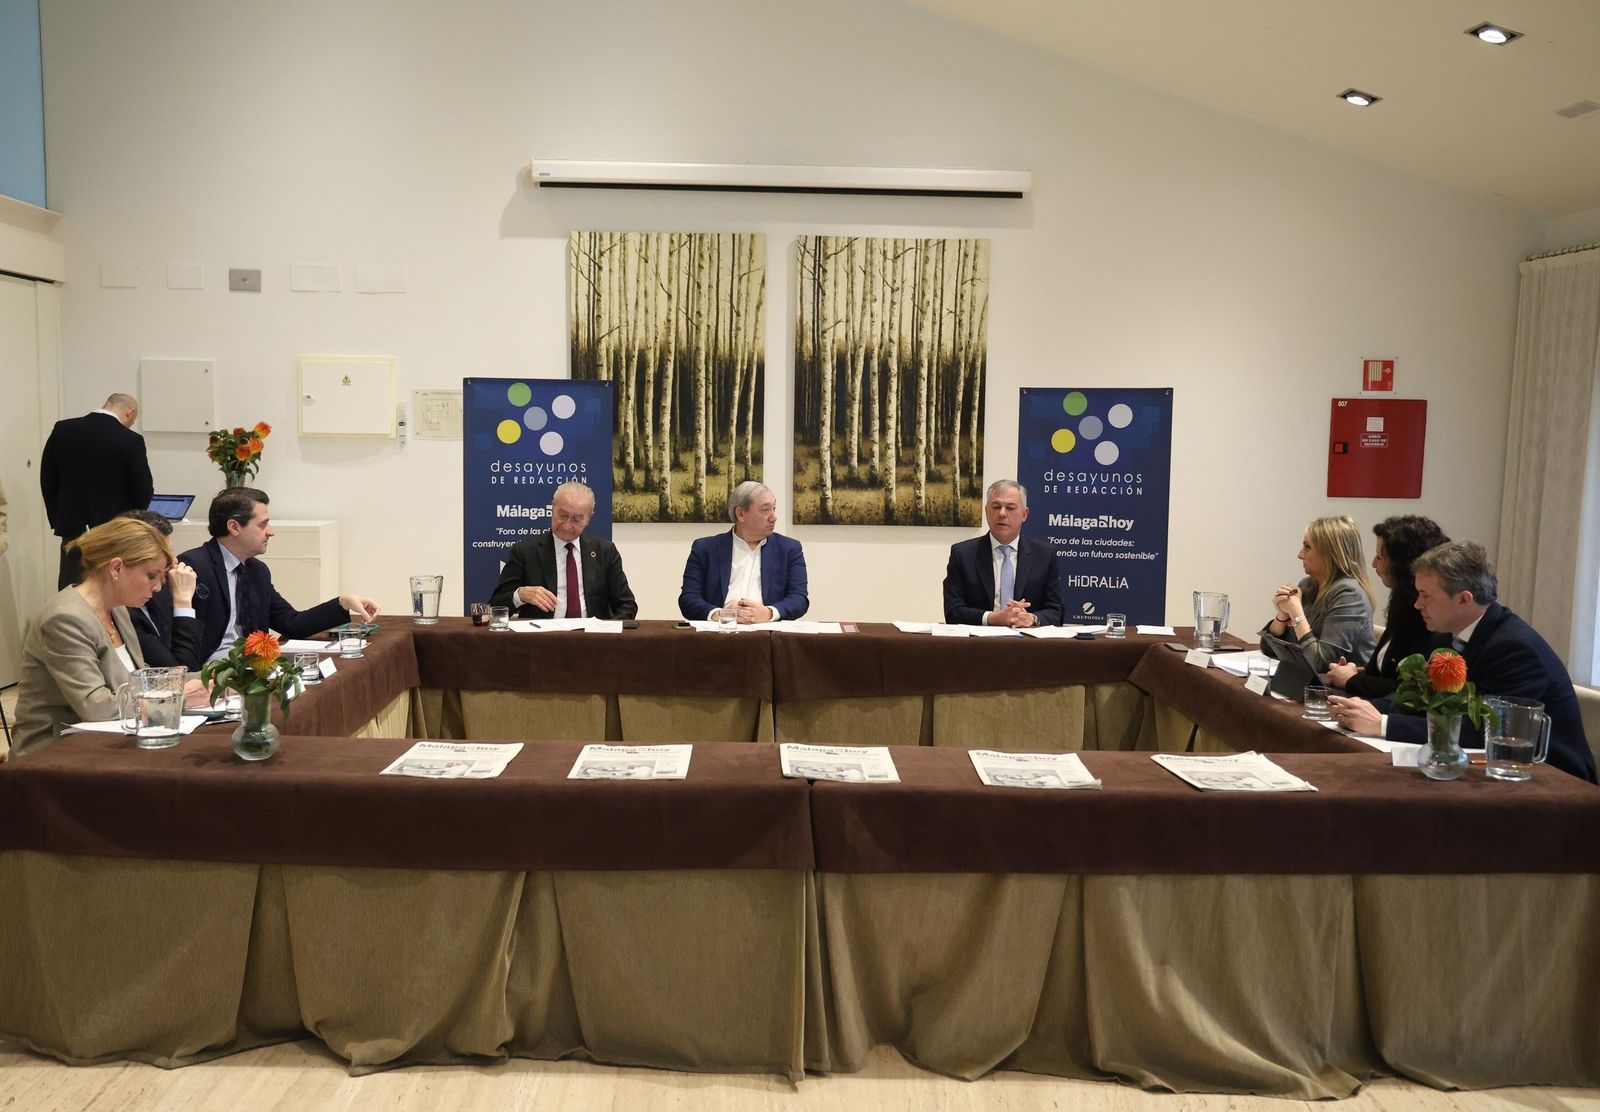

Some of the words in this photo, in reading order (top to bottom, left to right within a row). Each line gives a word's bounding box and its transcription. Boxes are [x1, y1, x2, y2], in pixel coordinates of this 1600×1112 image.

[490, 460, 587, 475] desayunos
[491, 476, 505, 484] DE
[513, 474, 587, 485] REDACCIÓN
[1043, 469, 1143, 485] desayunos
[1044, 485, 1058, 493] DE
[1066, 484, 1143, 495] REDACCIÓN
[517, 527, 529, 536] de
[530, 527, 541, 536] las
[1068, 536, 1080, 546] de
[1081, 537, 1093, 546] las
[1094, 538, 1135, 547] ciudades:
[1091, 550, 1113, 559] futuro
